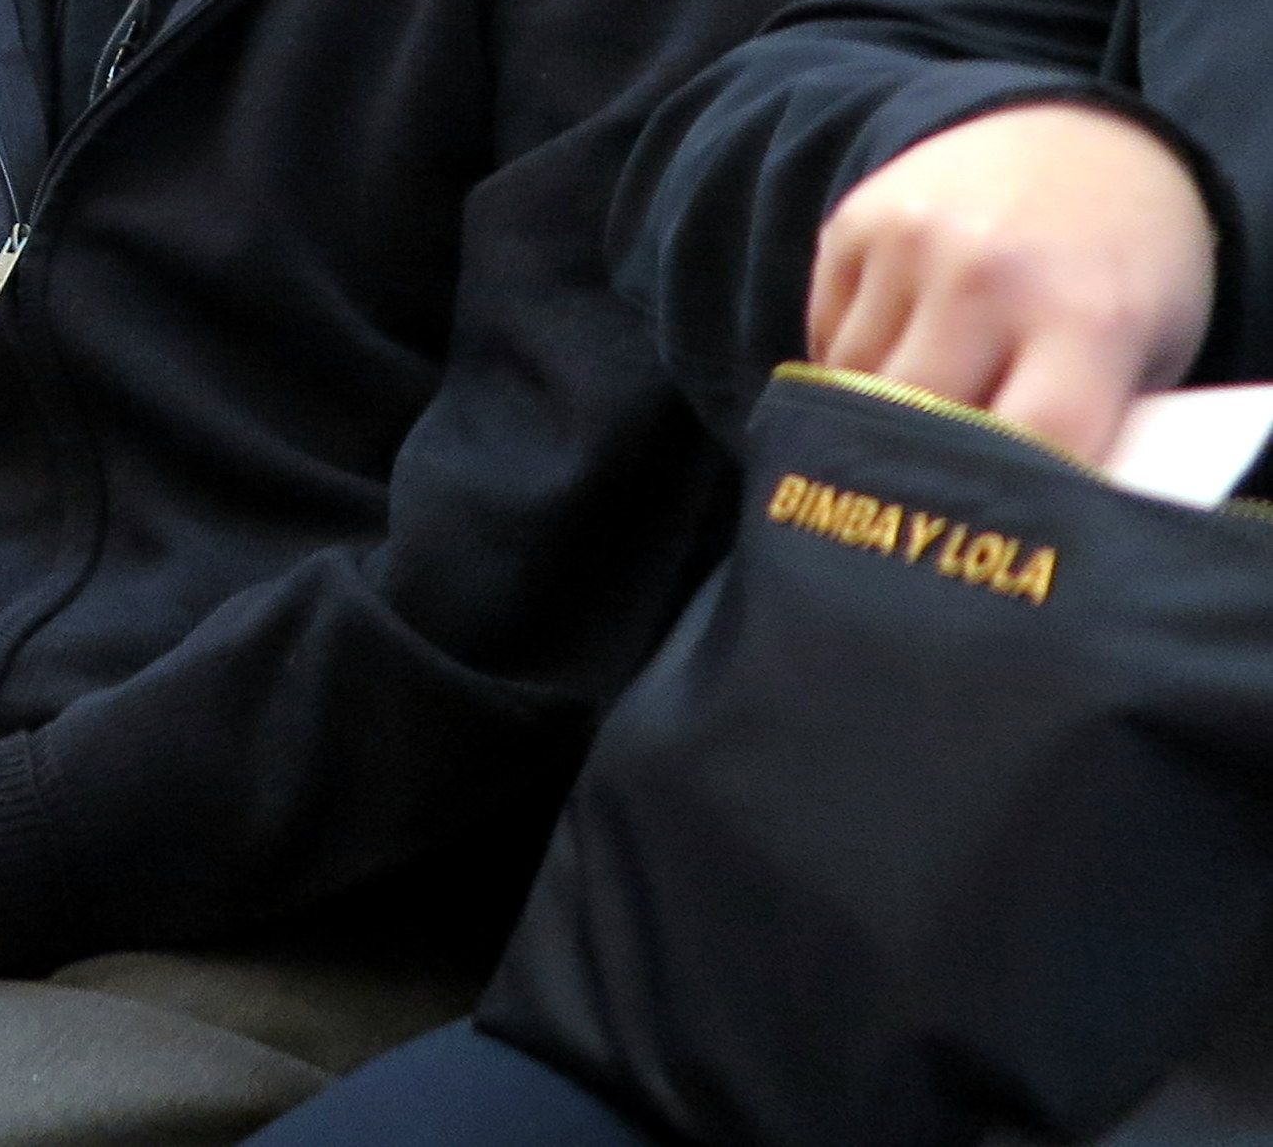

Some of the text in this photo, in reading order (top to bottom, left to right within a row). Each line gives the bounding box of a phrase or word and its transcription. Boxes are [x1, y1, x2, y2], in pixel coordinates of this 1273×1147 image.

[768, 472, 1058, 606] BIMBA Y LOLA
